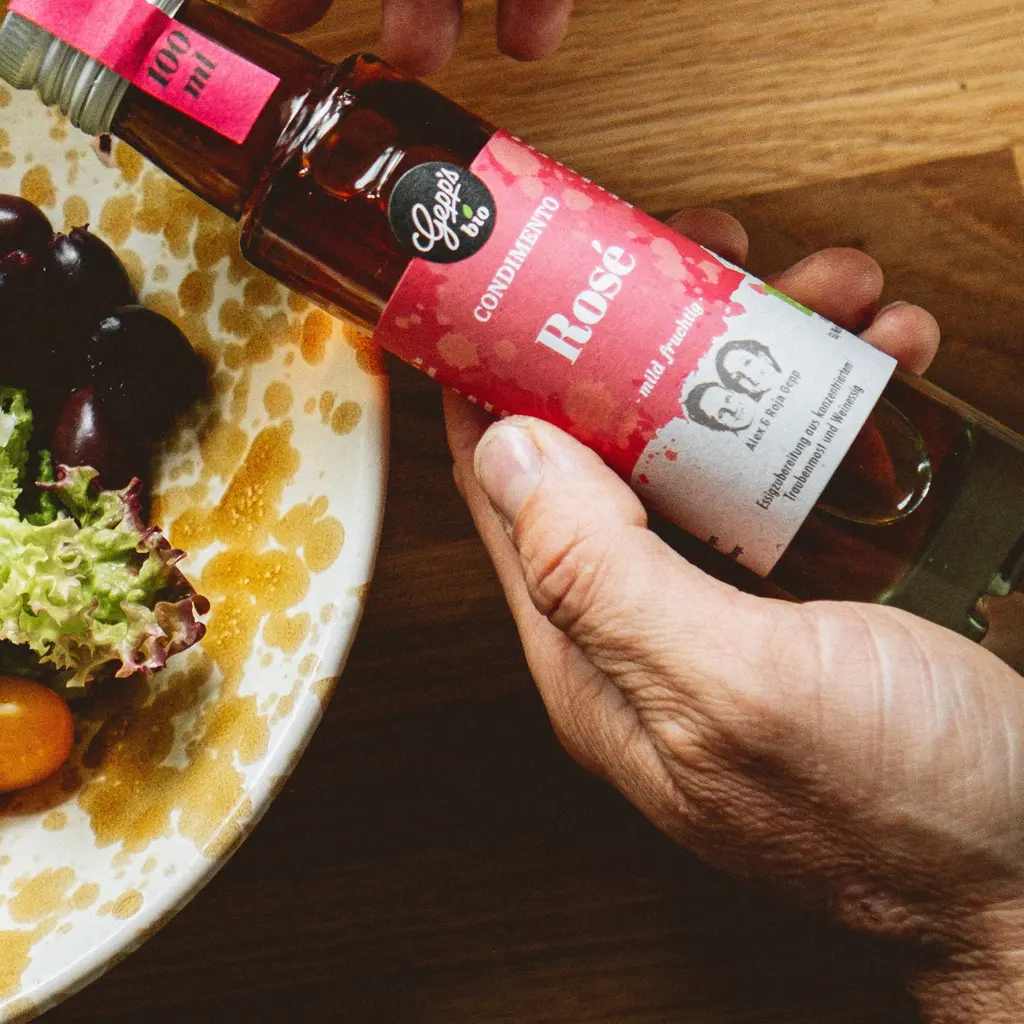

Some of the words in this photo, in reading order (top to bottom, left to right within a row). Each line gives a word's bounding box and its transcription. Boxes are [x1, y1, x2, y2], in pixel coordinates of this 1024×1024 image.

[148, 31, 191, 88] 100
[184, 51, 216, 99] ml
[412, 167, 461, 253] Gepp's
[460, 205, 490, 238] bio
[473, 195, 561, 323] CONDIMENTO
[535, 239, 636, 366] Rosé
[639, 359, 666, 398] mild
[659, 301, 704, 365] fruchtig
[745, 427, 766, 452] Alex
[779, 369, 801, 394] Gepp
[806, 419, 821, 437] aus
[811, 361, 854, 418] konzentriertem
[756, 435, 812, 511] Essigzubereitung
[783, 443, 827, 502] Traubenmost
[823, 422, 838, 444] und
[831, 384, 865, 424] Weinessig
